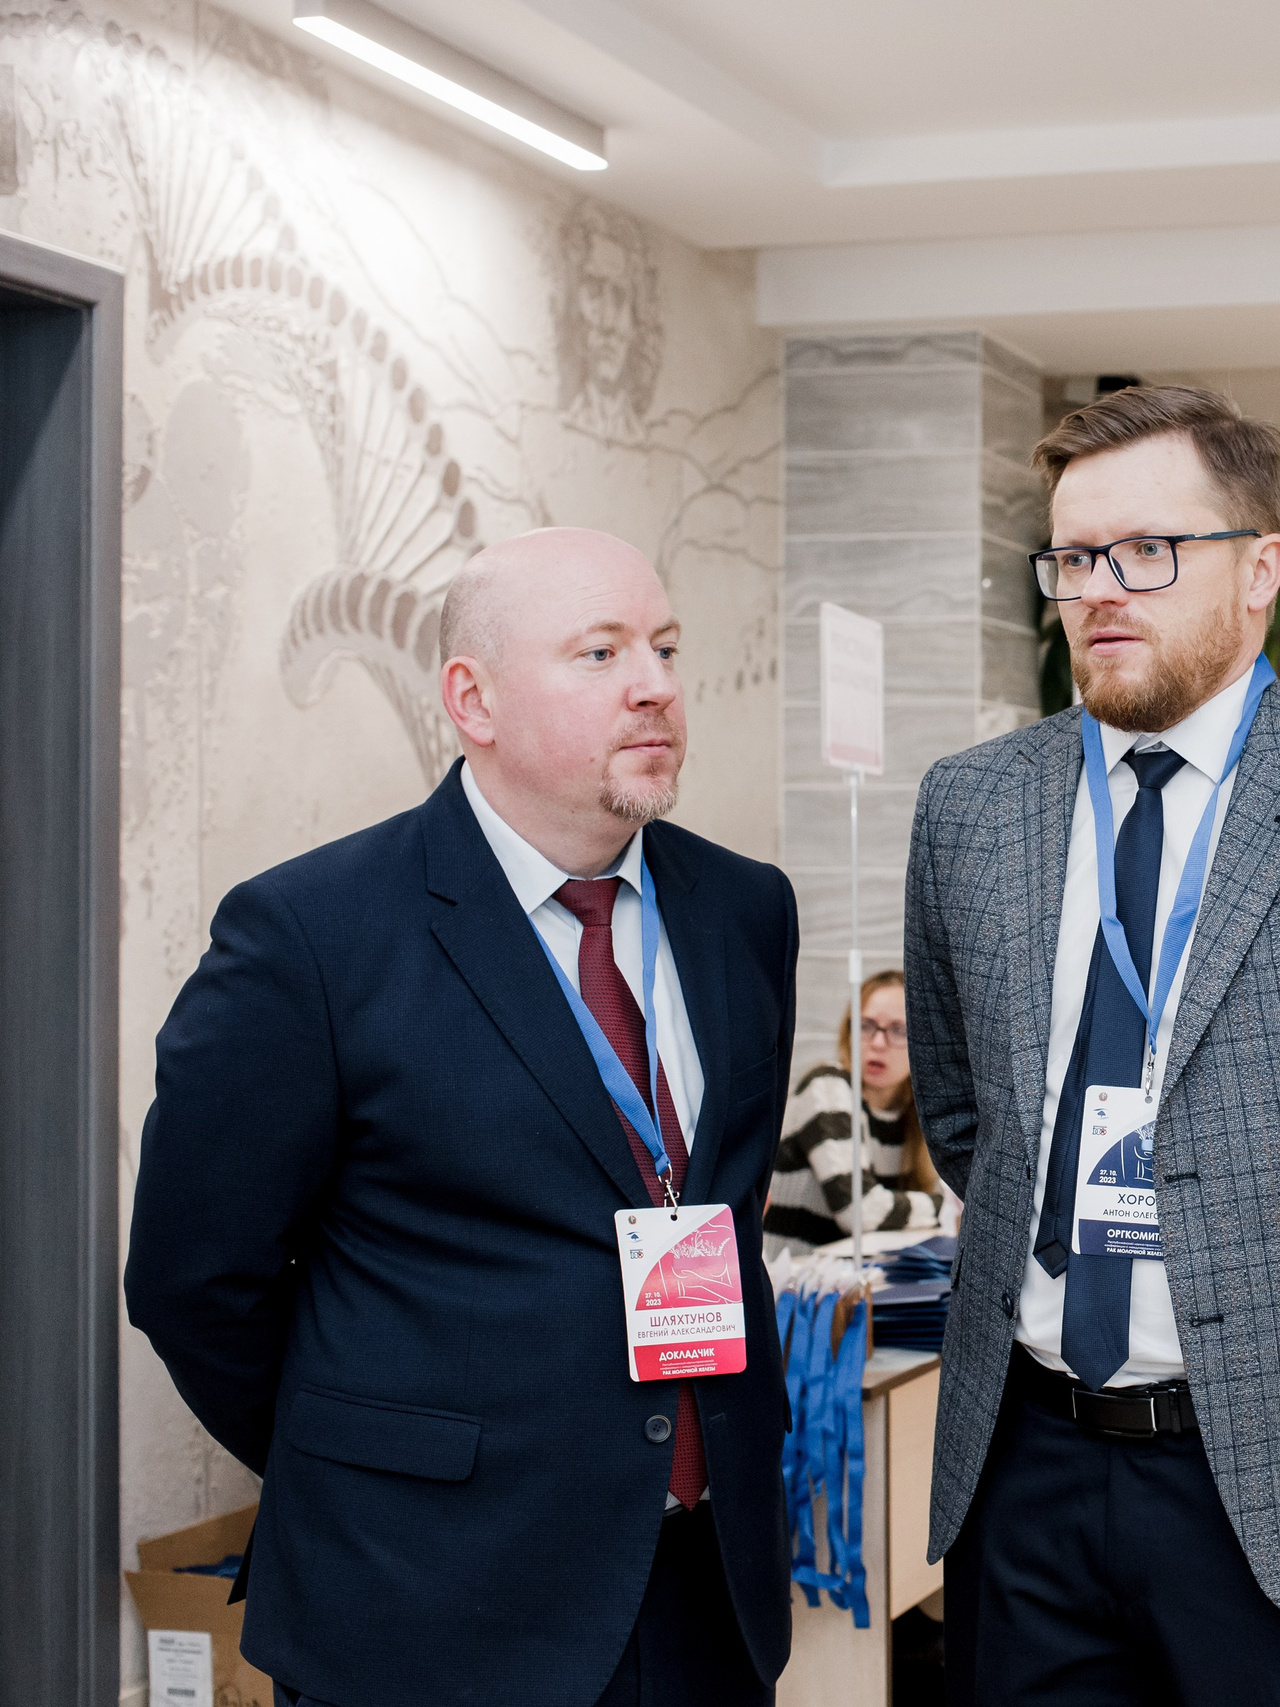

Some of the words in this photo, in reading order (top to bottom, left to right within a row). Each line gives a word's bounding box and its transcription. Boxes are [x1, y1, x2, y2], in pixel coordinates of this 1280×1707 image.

[1099, 1176, 1116, 1184] 2023
[1117, 1193, 1156, 1206] ХОРО
[1103, 1209, 1130, 1217] АНТОН
[1133, 1211, 1158, 1219] ОЛЕГО
[650, 1312, 722, 1327] ШЛЯХТУНОВ
[637, 1328, 669, 1338] ЕВГЕНИЙ
[671, 1324, 736, 1336] АЛЕКСАНДРОВИЧ
[659, 1348, 715, 1361] ДОКЛАДЧИК
